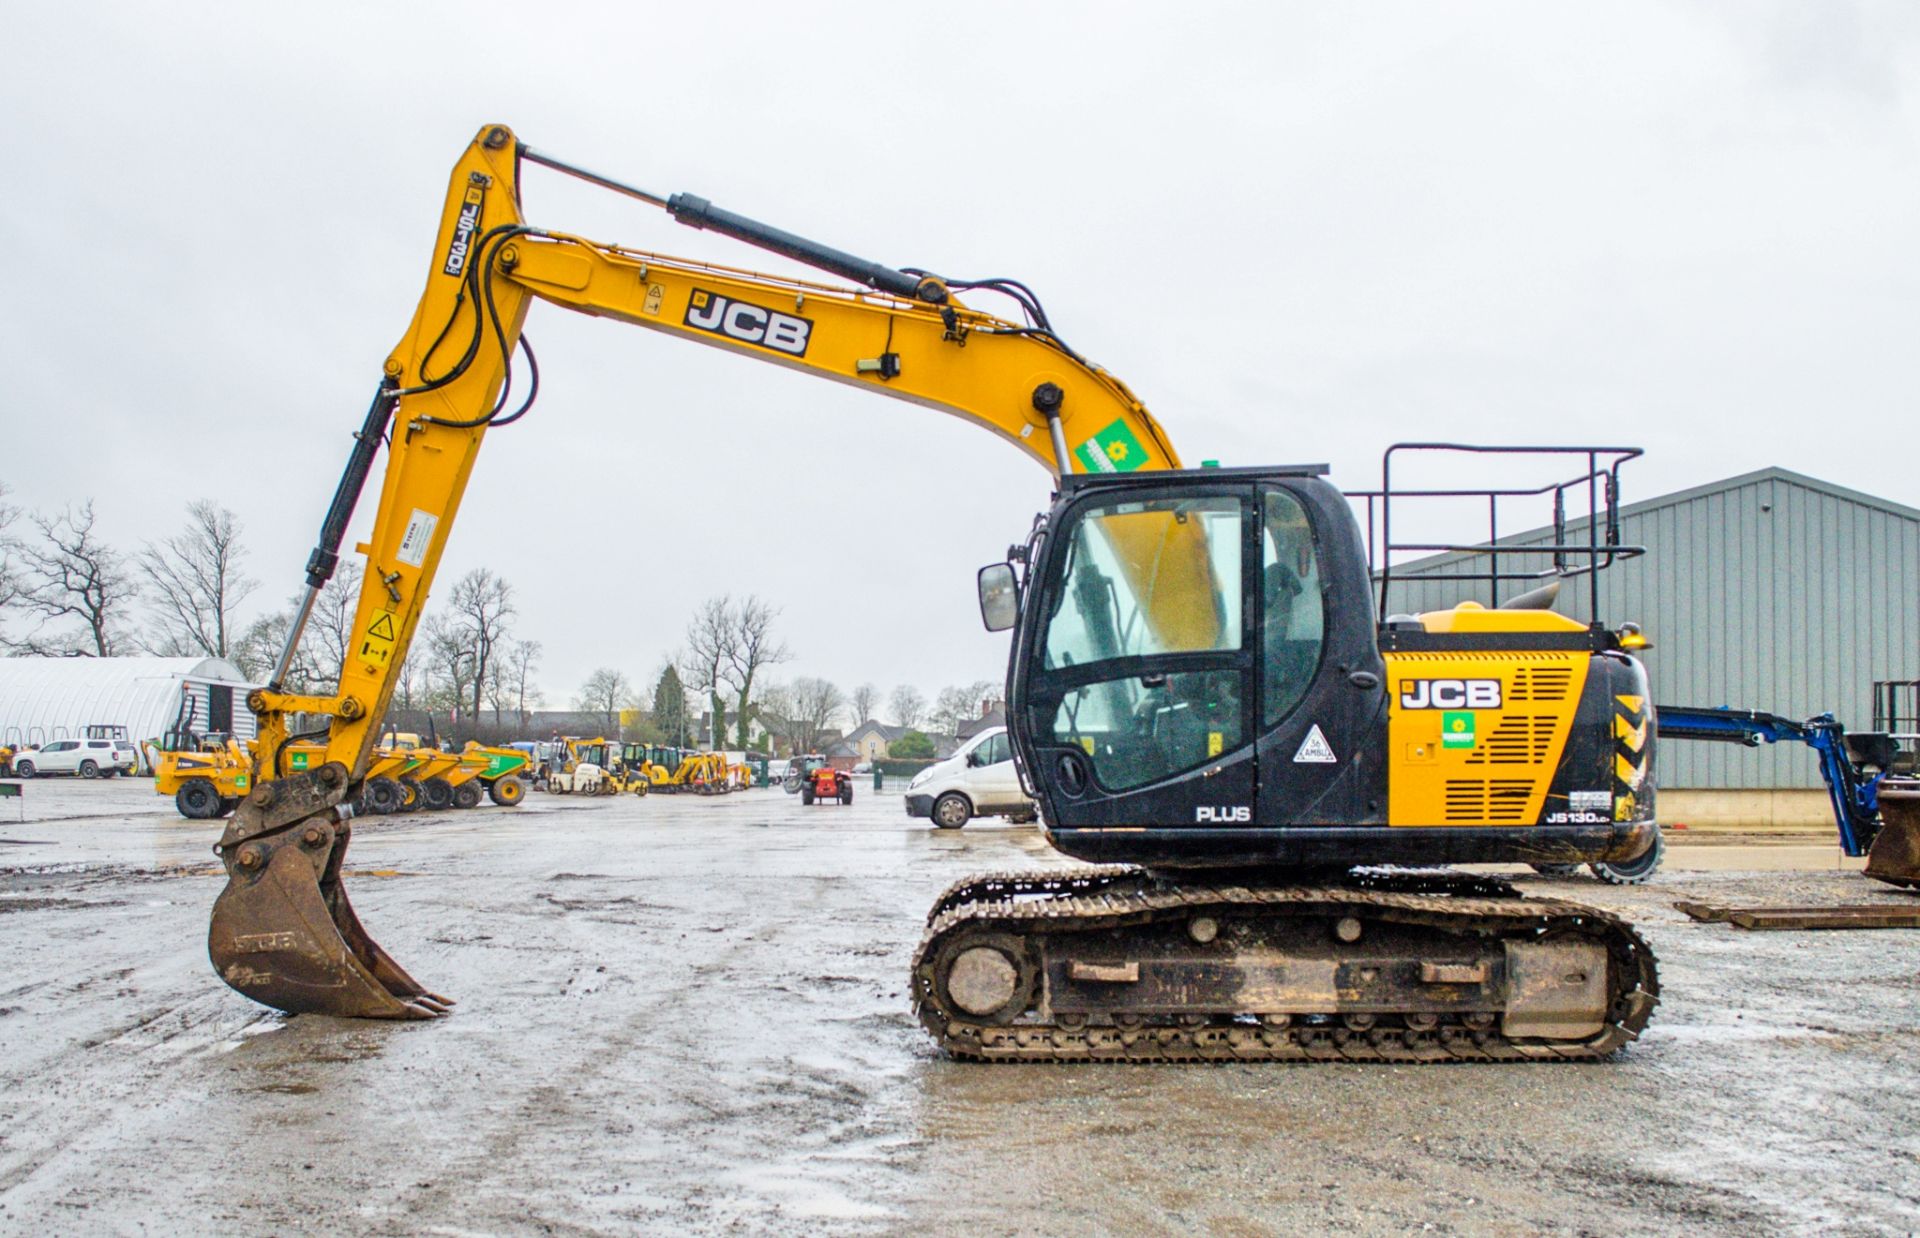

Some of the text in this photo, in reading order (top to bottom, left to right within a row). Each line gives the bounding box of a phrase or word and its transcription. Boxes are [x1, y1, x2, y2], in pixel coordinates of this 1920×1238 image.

[447, 205, 478, 269] JS130
[688, 296, 809, 354] JCB
[1402, 680, 1501, 709] JCB
[1196, 806, 1251, 822] PLUS
